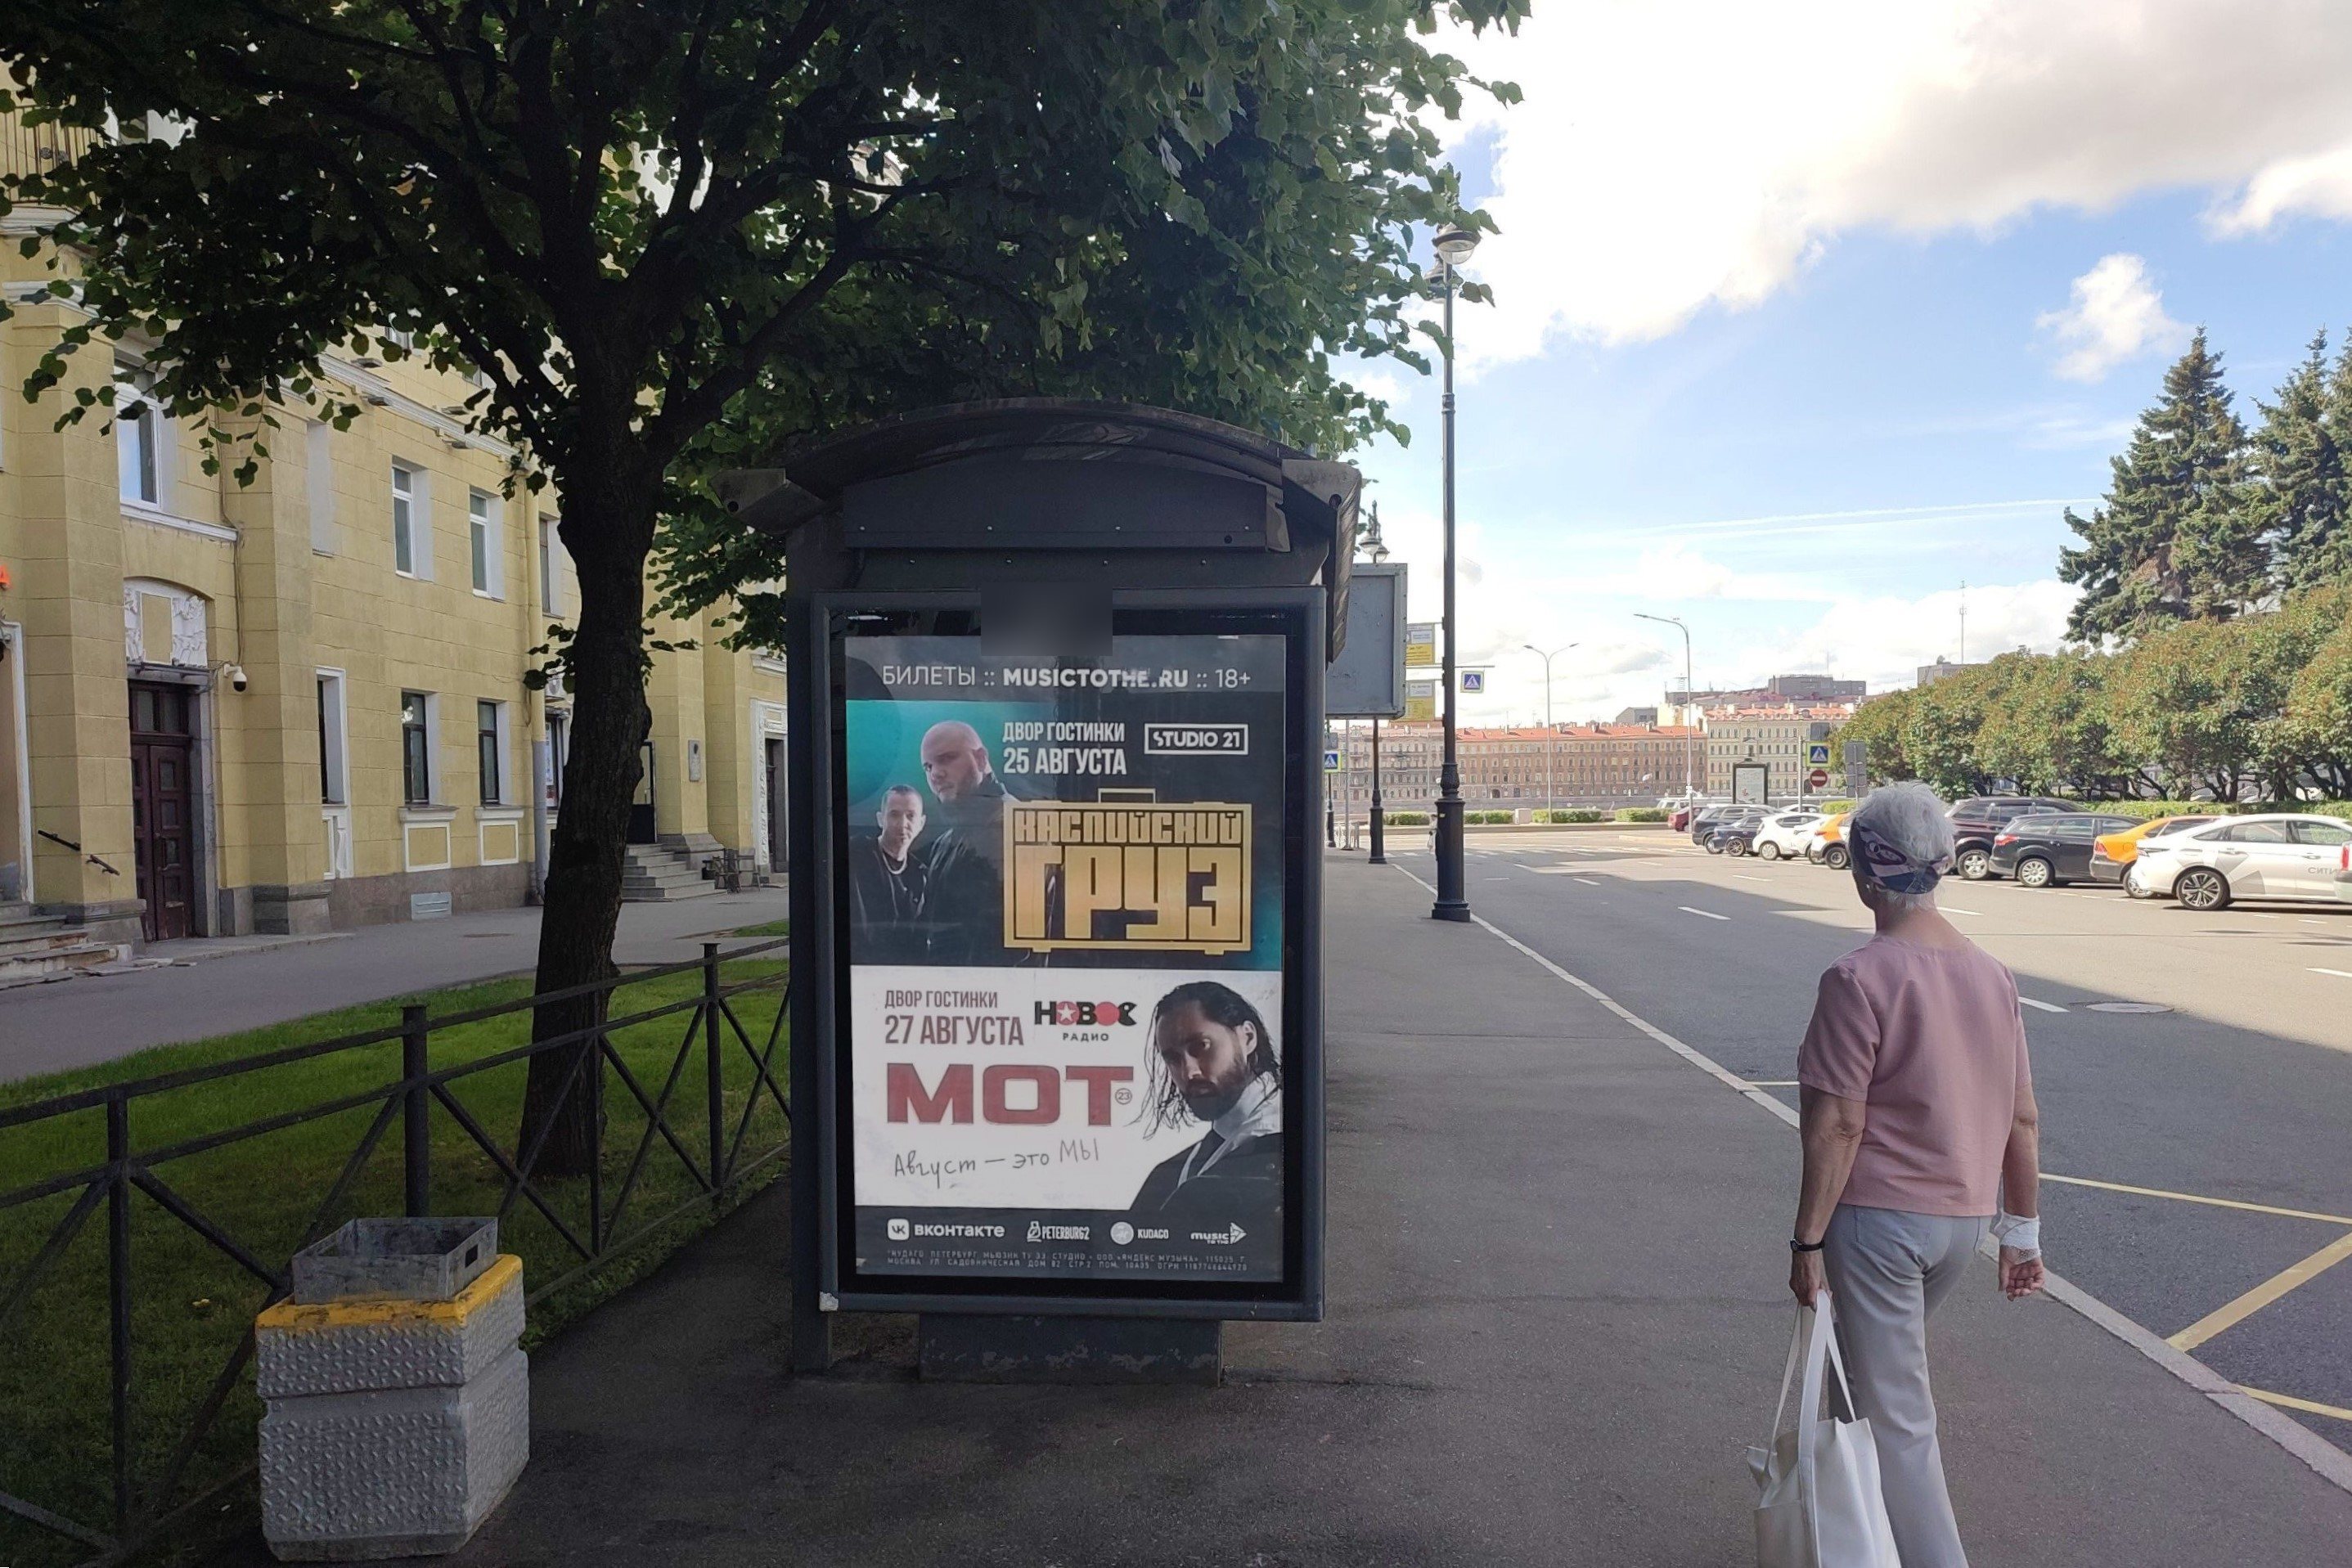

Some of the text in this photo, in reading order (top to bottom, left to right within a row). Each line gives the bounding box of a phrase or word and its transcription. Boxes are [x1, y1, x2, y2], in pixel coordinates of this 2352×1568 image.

[882, 665, 976, 686] БИЛЕТЫ
[1003, 668, 1189, 688] MUSICTOTHE.RU
[1215, 669, 1251, 688] 18+
[1002, 721, 1125, 743] ДВОР ГОСТИНКИ
[1153, 731, 1240, 748] STUDIO 21
[1003, 748, 1127, 775] 25 АВГУСТА
[1014, 810, 1242, 844] КАСПИЙСКИЙ
[1015, 845, 1242, 941] ГРУЗ
[884, 990, 997, 1009] ДВОР ГОСТИНКИ
[885, 1015, 1024, 1045] 27 АВГУСТА
[1063, 1032, 1109, 1042] РАДИО
[888, 1063, 1134, 1126] МОТ
[894, 1150, 976, 1188] Август
[1012, 1153, 1050, 1169] это
[1137, 1229, 1169, 1240] KUDAGO
[1190, 1232, 1230, 1240] music
[930, 1251, 978, 1259] ПЕТЕРБУРГ
